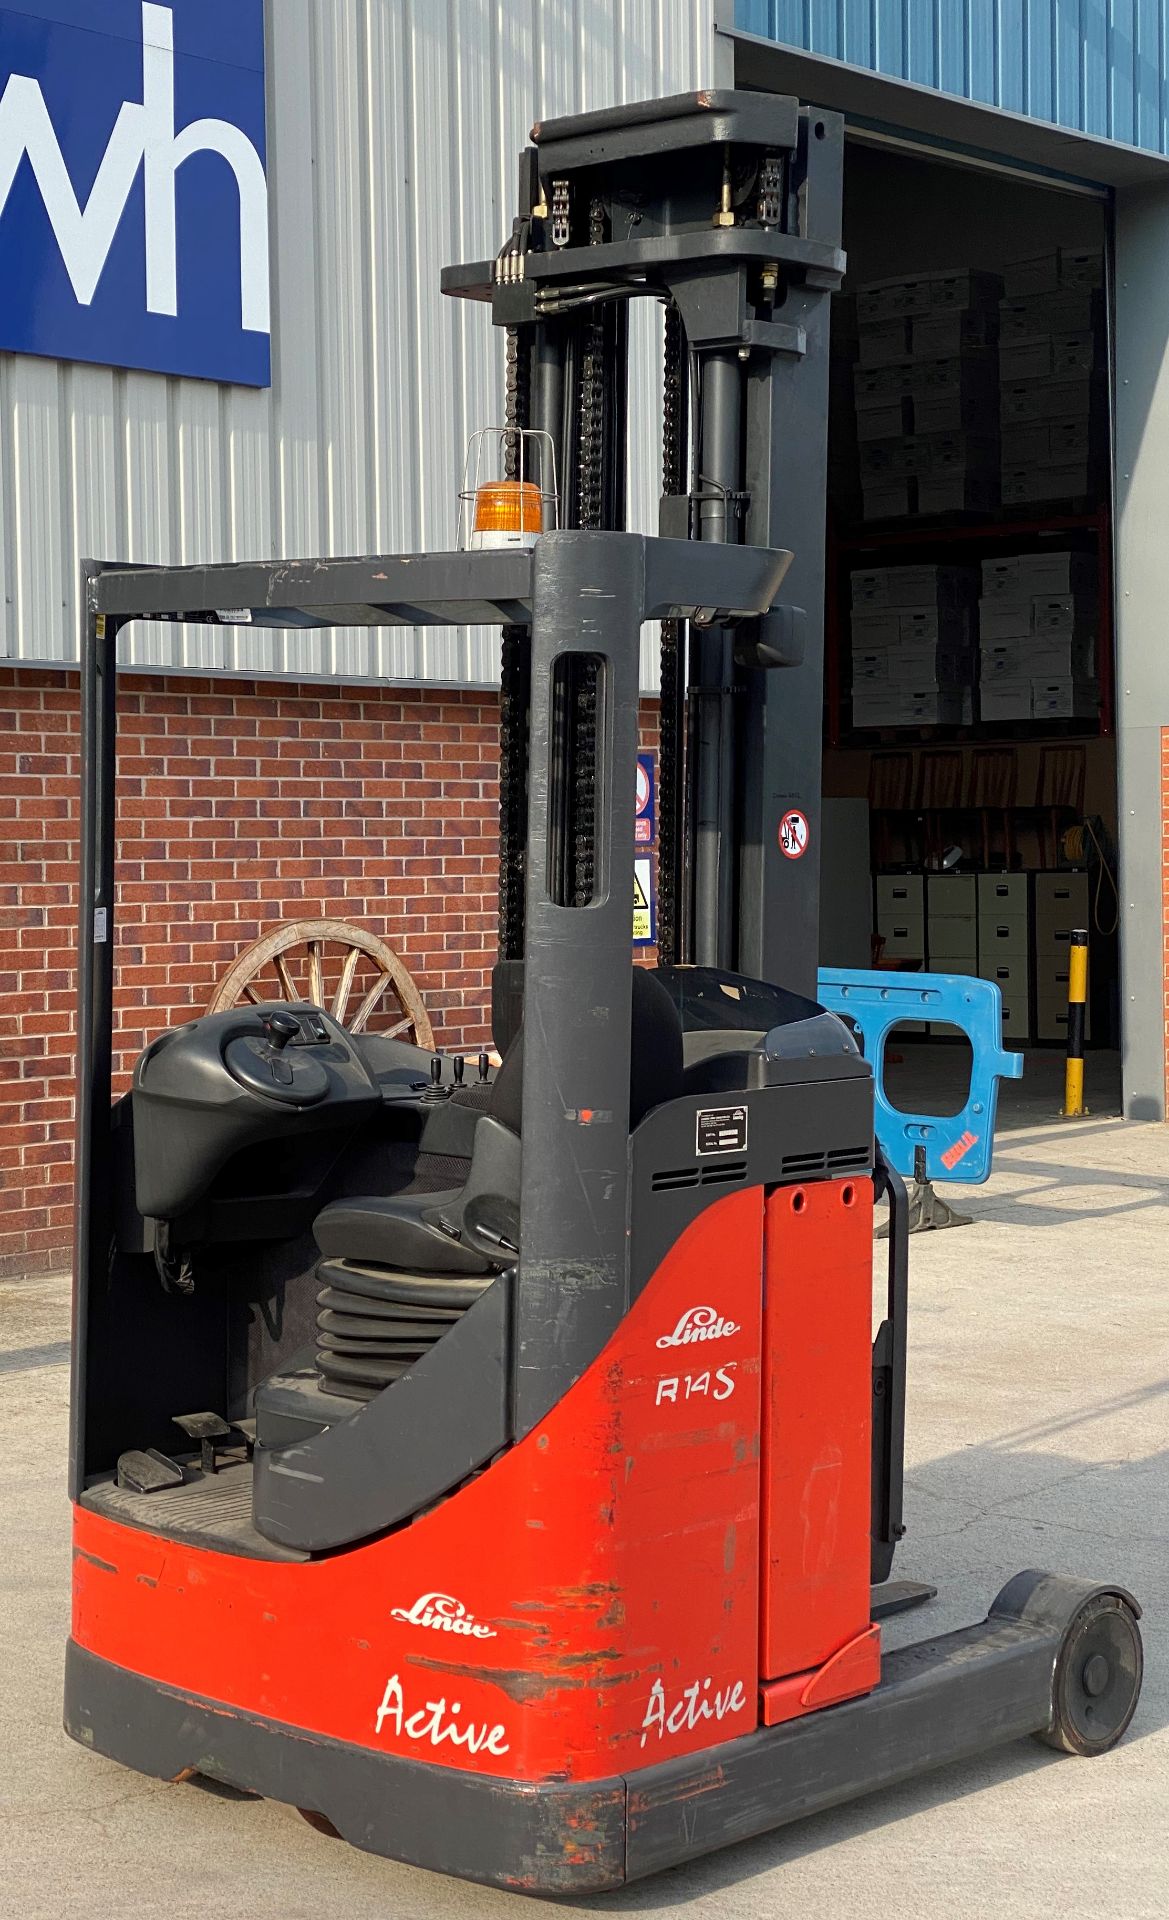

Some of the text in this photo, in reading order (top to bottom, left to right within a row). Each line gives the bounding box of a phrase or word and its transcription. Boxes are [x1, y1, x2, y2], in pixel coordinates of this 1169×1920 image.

[656, 1306, 741, 1348] Linde
[375, 1674, 510, 1756] Active
[640, 1677, 746, 1749] Active
